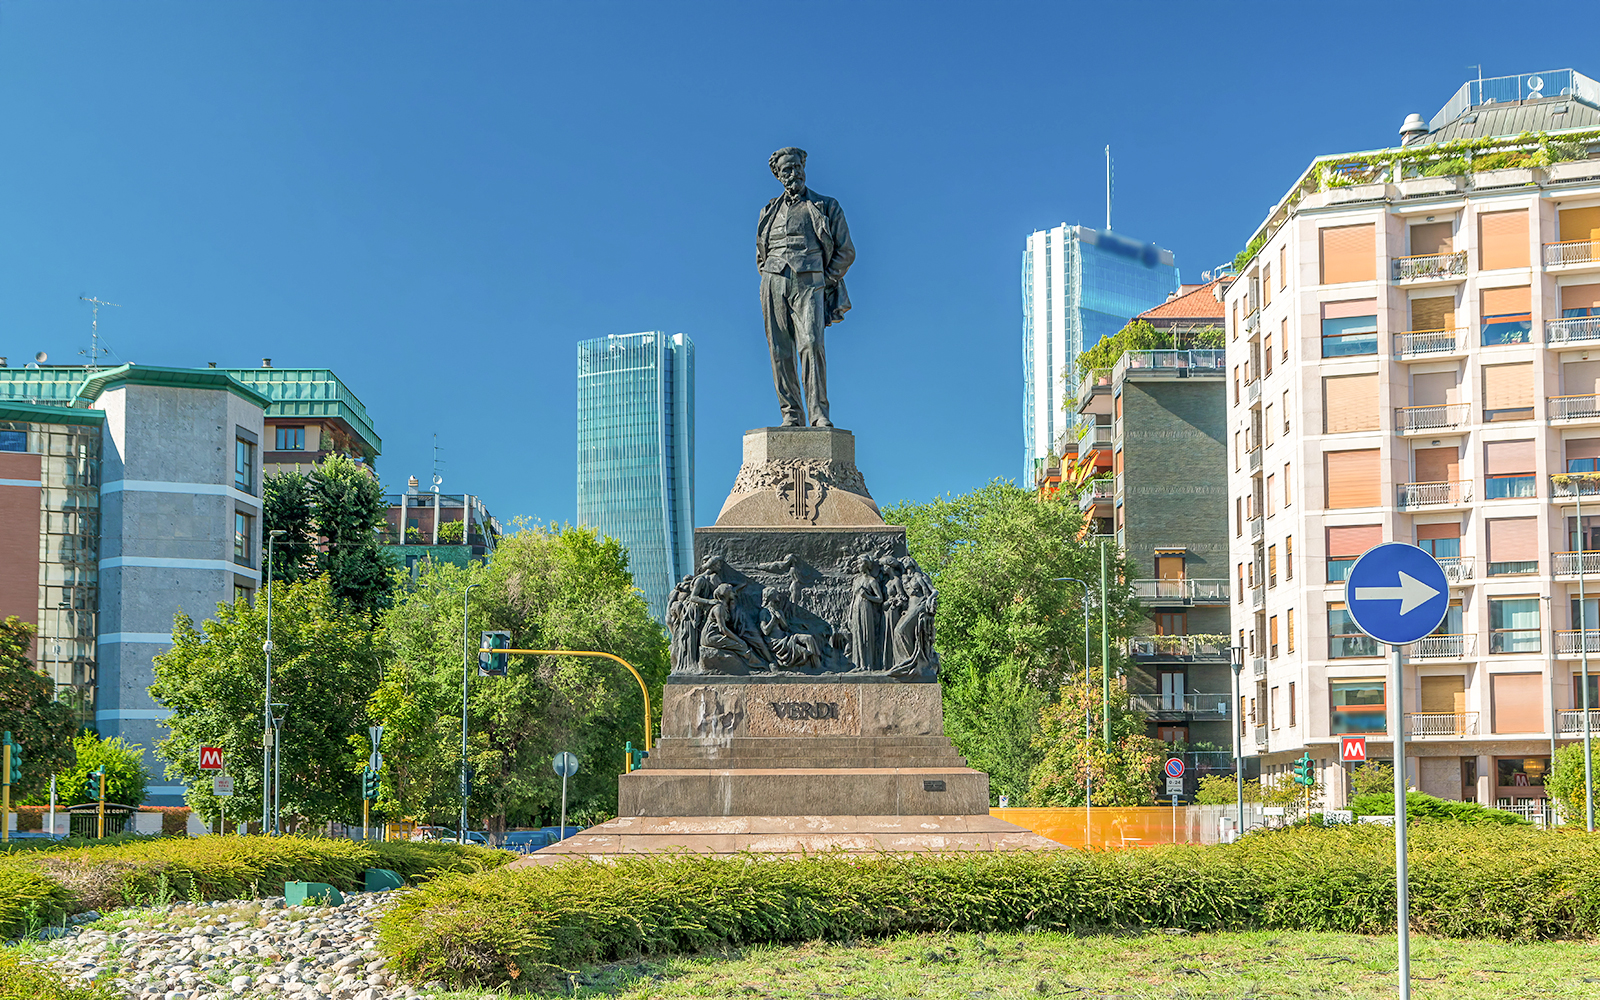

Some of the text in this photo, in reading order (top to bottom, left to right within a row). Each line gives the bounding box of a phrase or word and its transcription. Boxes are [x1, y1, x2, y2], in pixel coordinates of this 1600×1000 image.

[771, 701, 839, 721] VERDI
[1344, 742, 1364, 756] M
[201, 750, 221, 765] M
